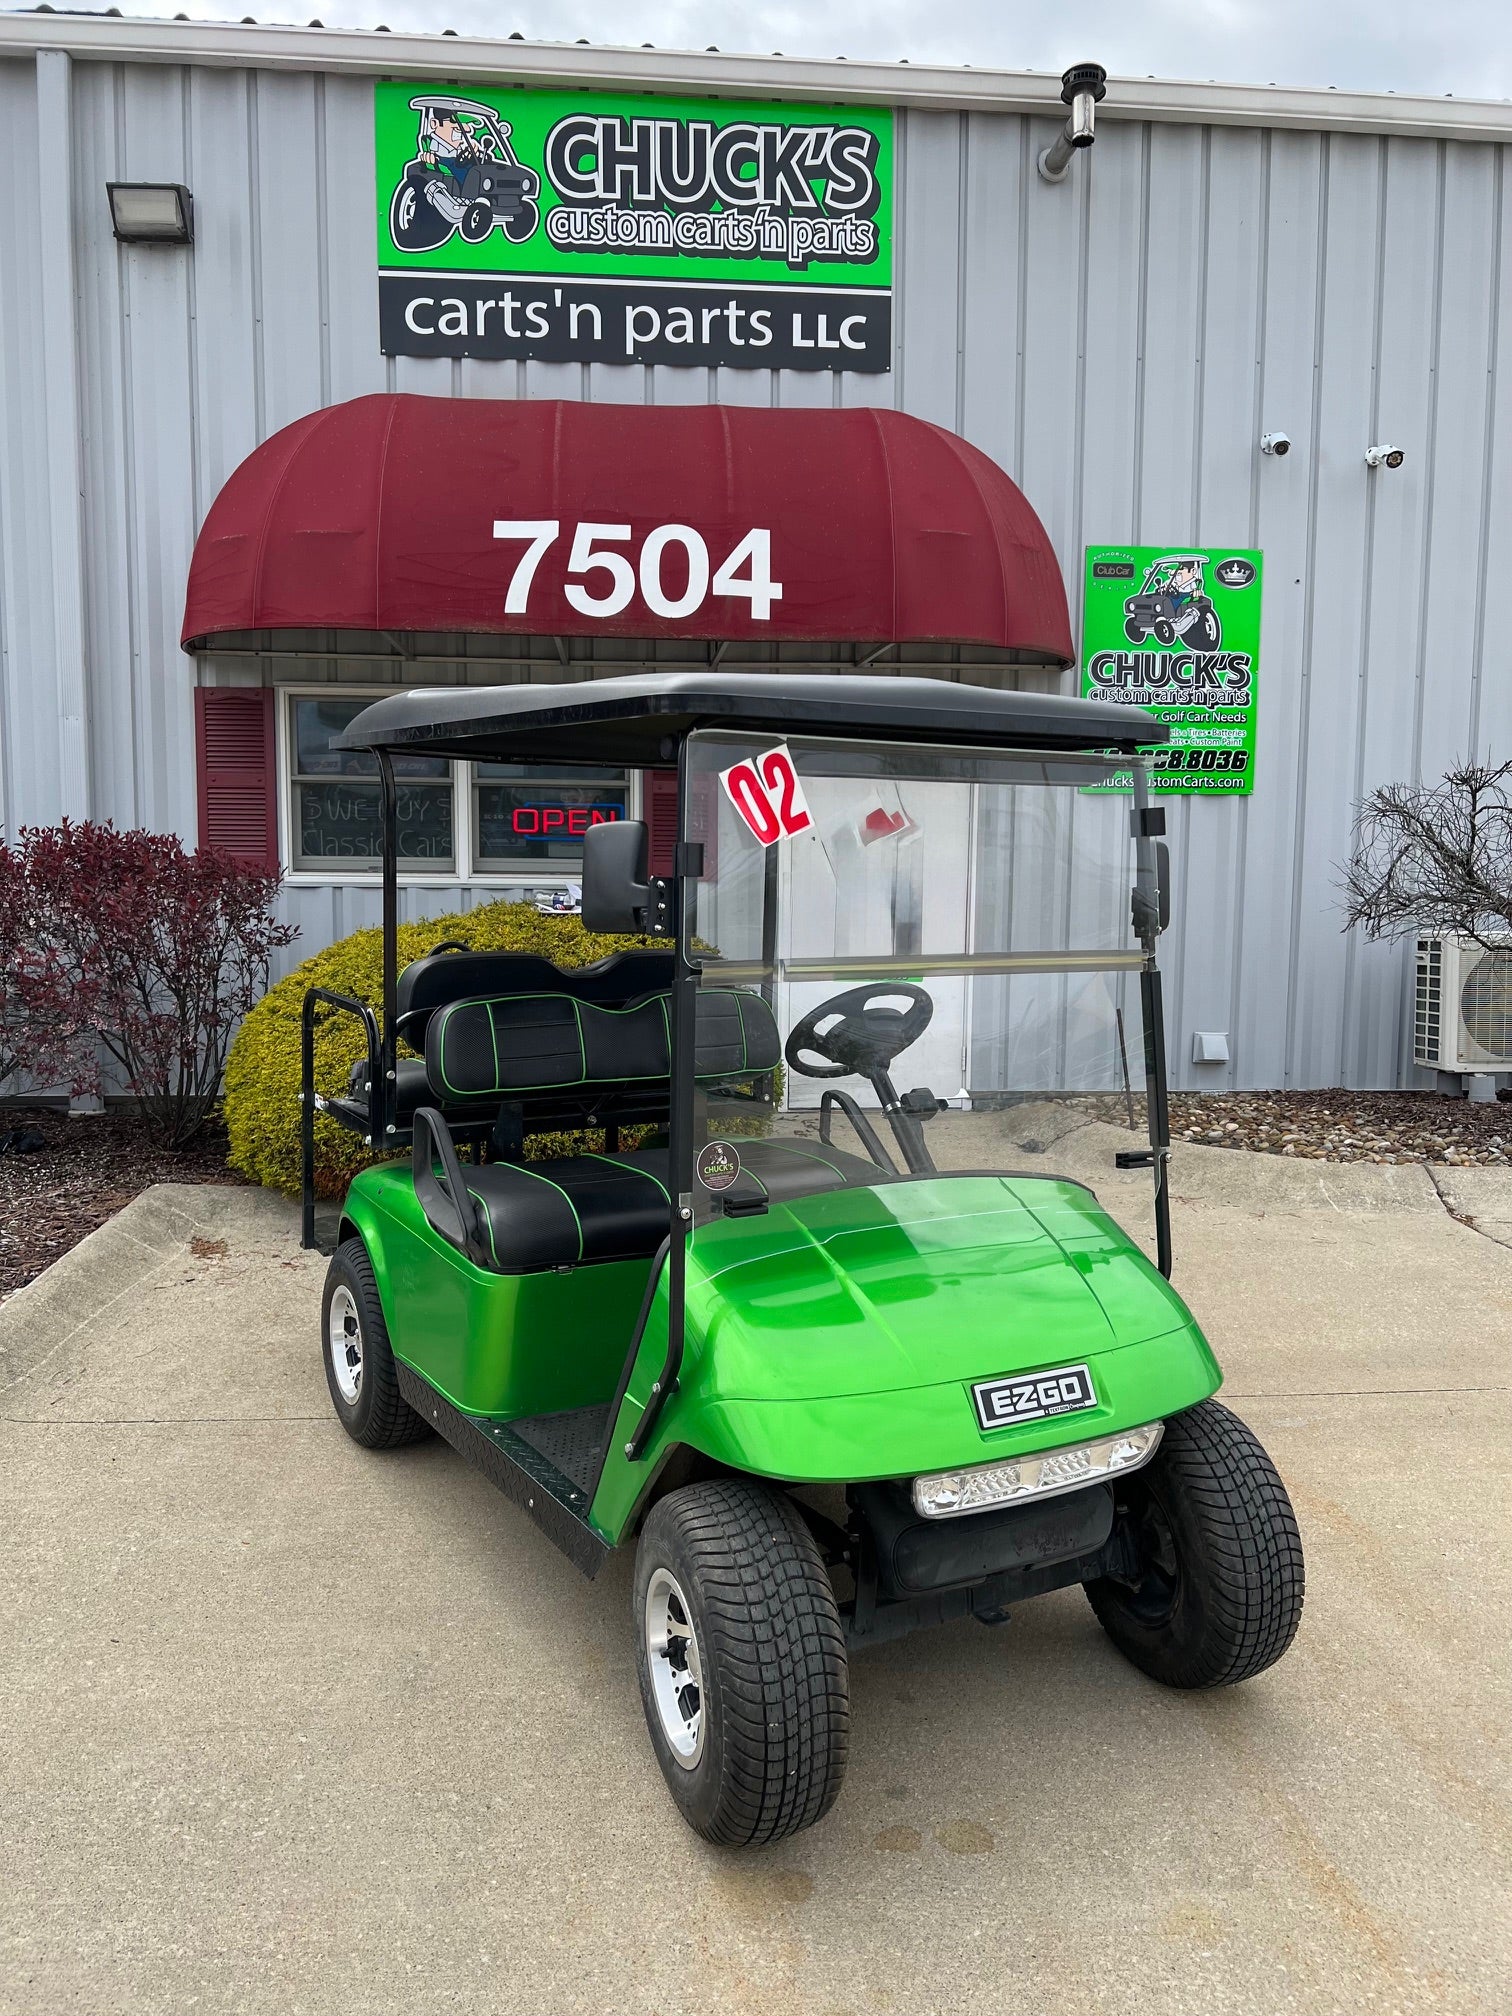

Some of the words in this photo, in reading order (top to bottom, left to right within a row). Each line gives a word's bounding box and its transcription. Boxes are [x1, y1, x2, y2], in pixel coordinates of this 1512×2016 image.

[545, 114, 877, 208] CHUCK'S
[547, 203, 673, 247] custom
[674, 208, 786, 253] carts'n
[788, 213, 874, 262] parts
[404, 288, 602, 340] carts'n
[625, 299, 774, 355] parts
[792, 313, 868, 350] LLC
[493, 519, 783, 621] 7504
[1097, 565, 1116, 575] Club
[1116, 566, 1130, 575] Car
[1090, 652, 1251, 688] CHUCK'S
[1090, 688, 1146, 703] custom
[1151, 687, 1204, 703] carts'n
[1206, 688, 1247, 707] parts
[1161, 710, 1185, 722] Golf
[1187, 710, 1210, 722] Cart
[1212, 711, 1247, 723] Needs
[1188, 728, 1207, 736] Tires
[1212, 728, 1246, 737] Batteries
[1190, 737, 1220, 745] Custom
[1222, 737, 1242, 746] Paint
[327, 798, 369, 822] WE
[728, 752, 811, 845] 02
[512, 807, 617, 835] OPEN
[704, 1163, 734, 1175] CHUCK'S
